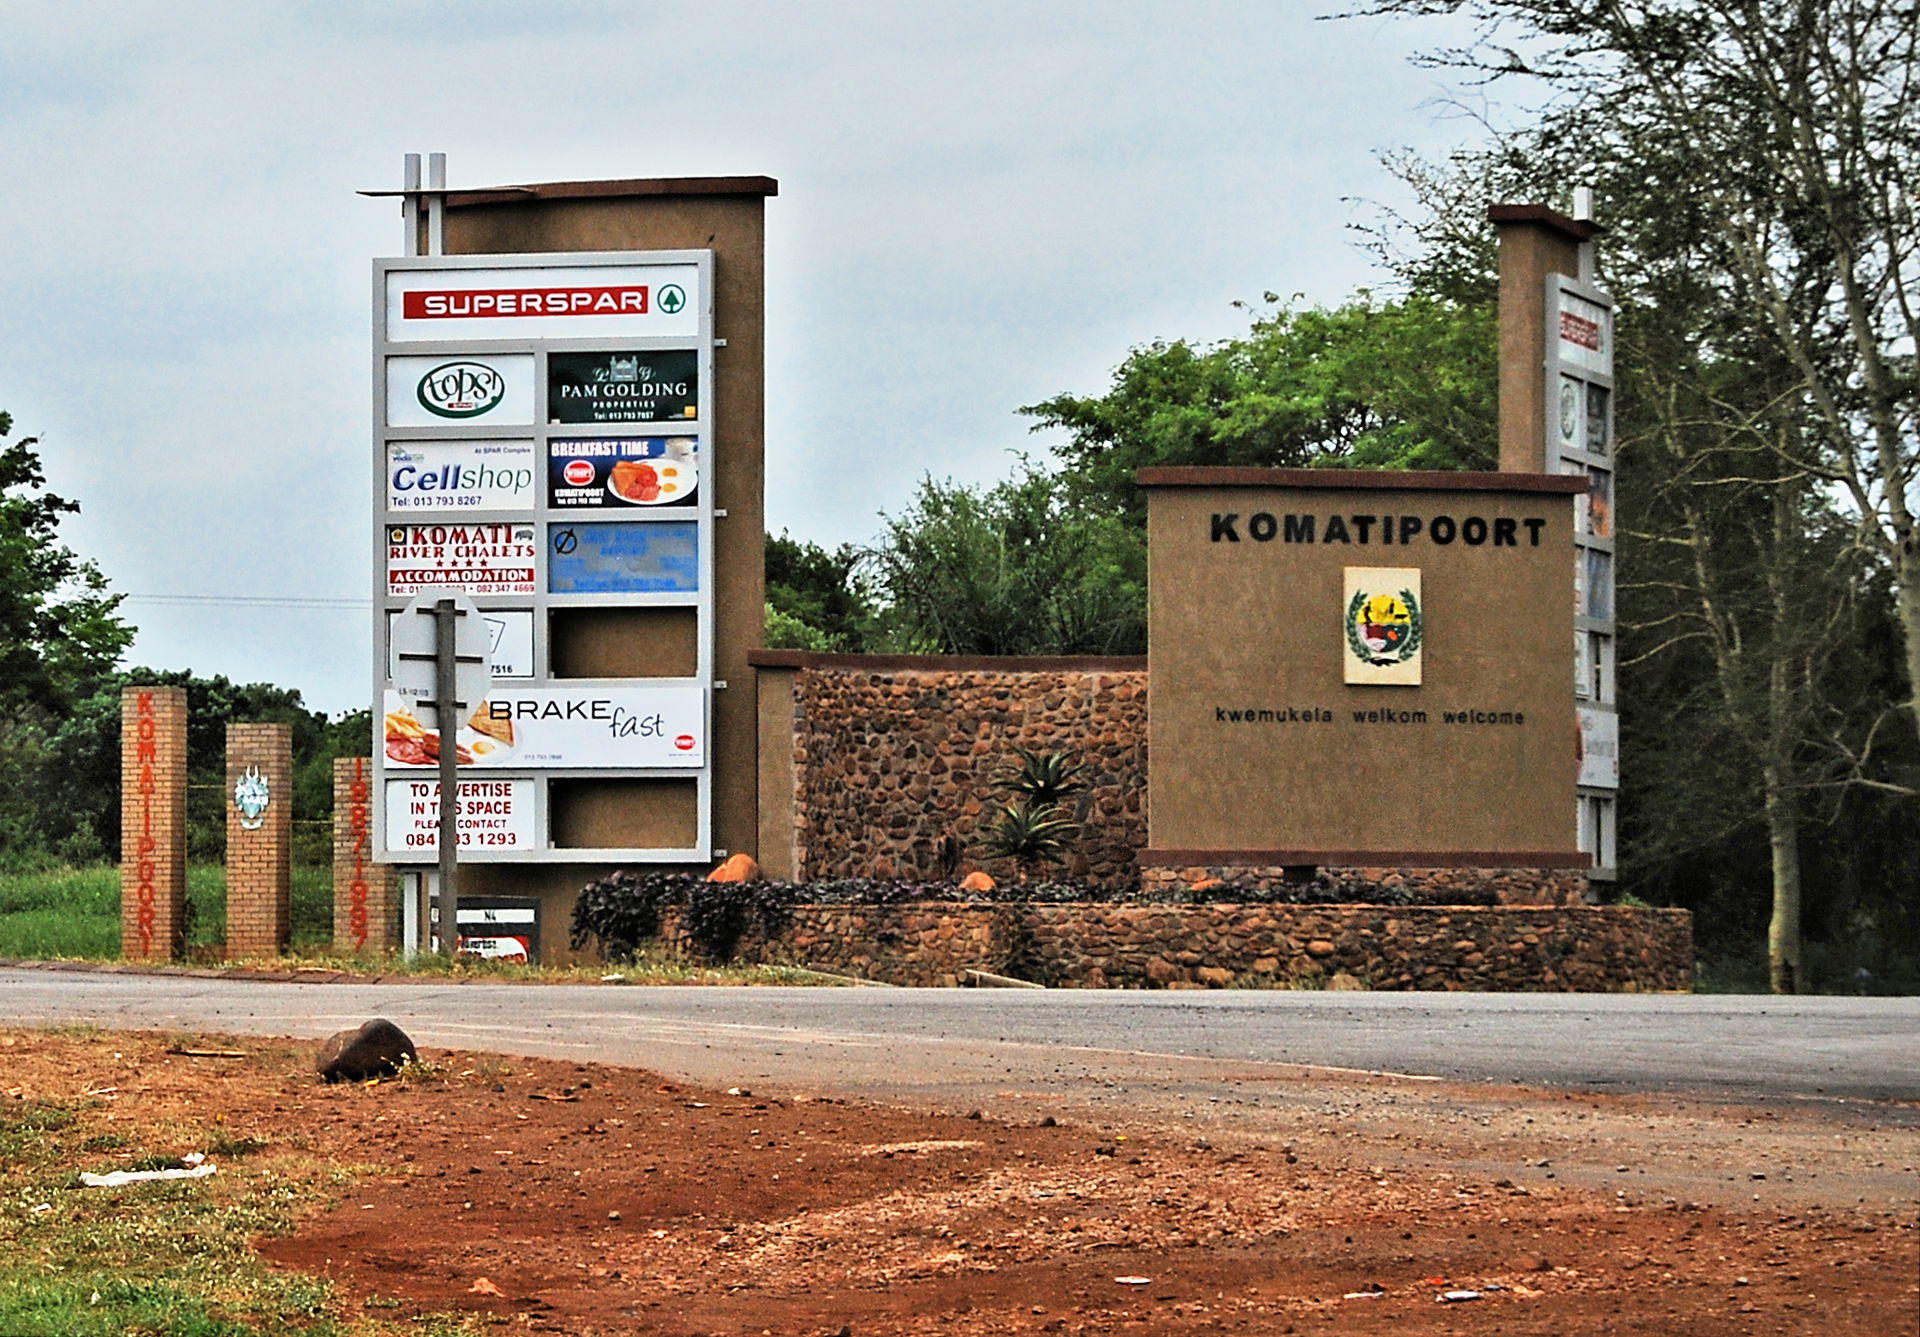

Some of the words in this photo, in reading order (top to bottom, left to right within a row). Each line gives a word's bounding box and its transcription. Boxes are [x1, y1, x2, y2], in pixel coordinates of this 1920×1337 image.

[425, 292, 642, 315] SUPERSPAR
[562, 384, 598, 398] PAM
[604, 383, 688, 397] GOLDING
[592, 400, 656, 409] PROPERTIES
[503, 447, 531, 455] Complex
[551, 442, 617, 456] BREAKFAST
[620, 441, 649, 456] TIME
[393, 465, 532, 495] Cellshop
[392, 497, 410, 507] Tel:
[414, 497, 432, 506] 013
[436, 497, 454, 506] 793
[411, 525, 512, 545] KOMATI
[1211, 513, 1545, 547] KOMATIPOORT
[390, 547, 445, 559] RIVER
[454, 545, 535, 558] CHALETS
[394, 570, 530, 583] ACCOMMODATION
[495, 585, 511, 593] 347
[490, 701, 611, 720] BRAKE
[609, 707, 665, 737] fast
[1215, 706, 1332, 723] kwemukela
[1352, 706, 1428, 724] welkom
[1443, 707, 1525, 725] welcome
[410, 784, 429, 797] TO
[411, 802, 425, 815] IN
[467, 801, 512, 814] SPACE
[138, 692, 156, 956] KOMATIPOORT
[457, 819, 507, 828] CONTACT
[406, 834, 435, 846] 084
[477, 833, 516, 845] 1293
